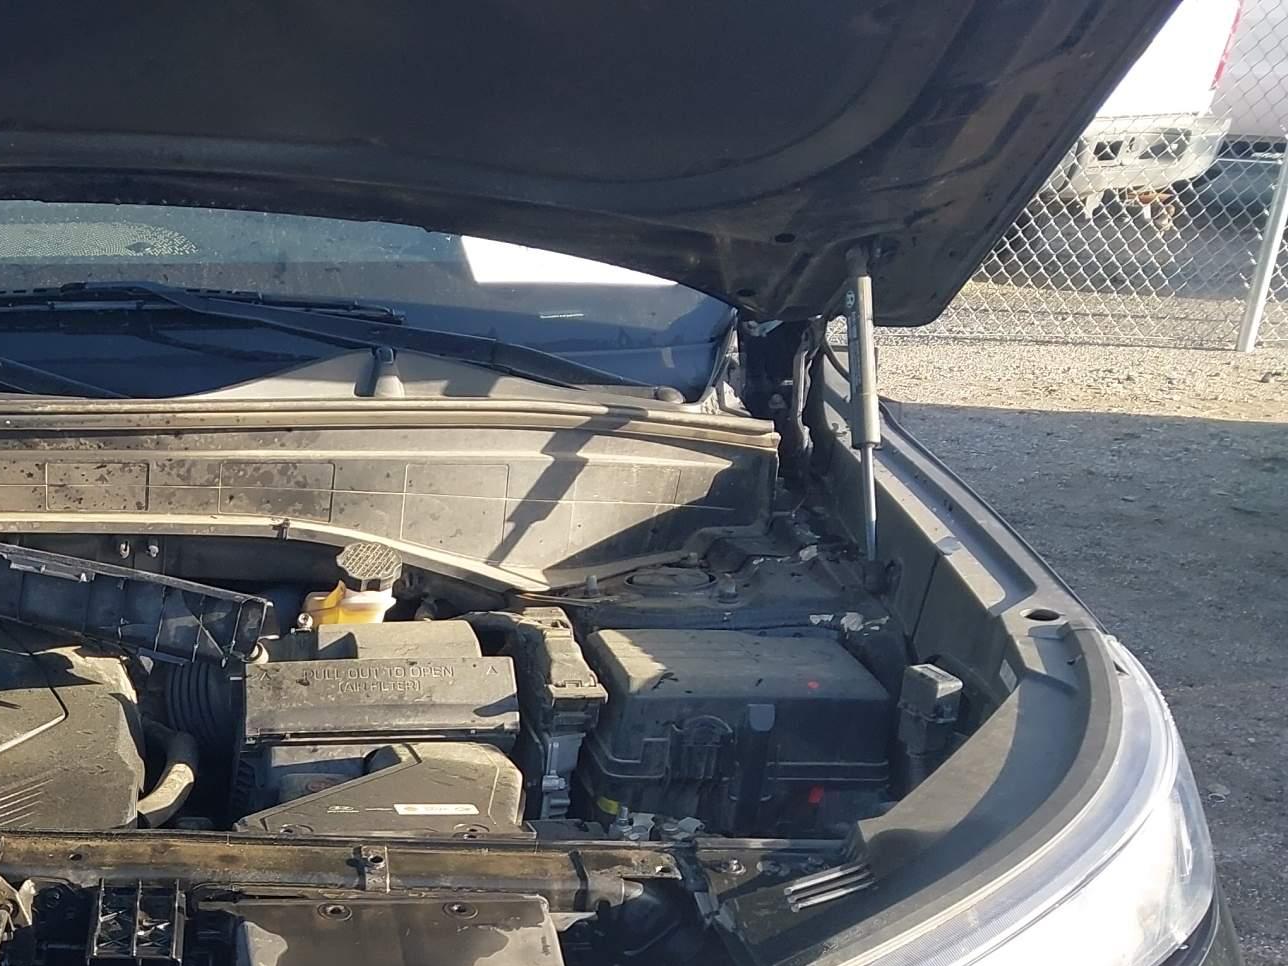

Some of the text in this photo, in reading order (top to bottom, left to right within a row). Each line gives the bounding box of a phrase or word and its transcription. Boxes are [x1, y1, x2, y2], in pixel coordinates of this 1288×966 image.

[303, 665, 455, 682] PULL OUT TO OPEN
